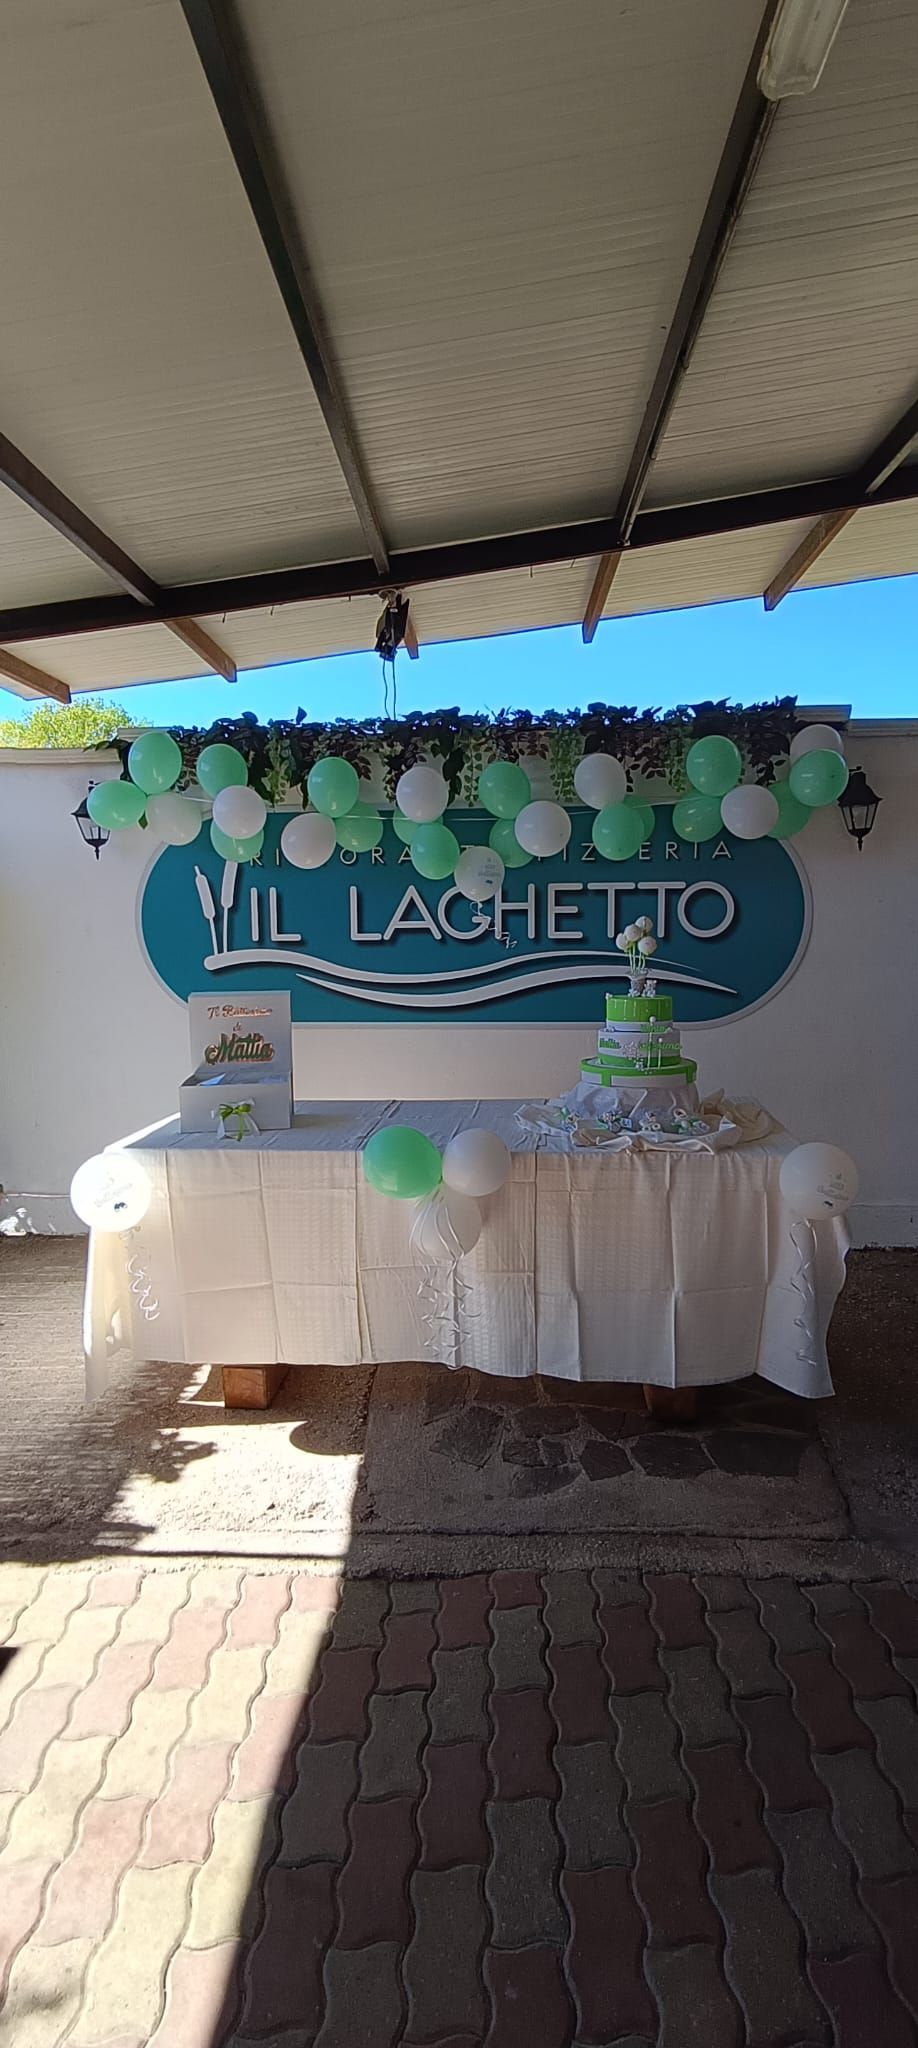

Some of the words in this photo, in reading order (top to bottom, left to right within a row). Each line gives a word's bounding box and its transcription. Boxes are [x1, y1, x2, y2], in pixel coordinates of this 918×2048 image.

[249, 845, 475, 867] RIORA
[537, 840, 733, 863] IZERIA
[249, 886, 302, 942] IL
[349, 880, 736, 942] LAGHETTO
